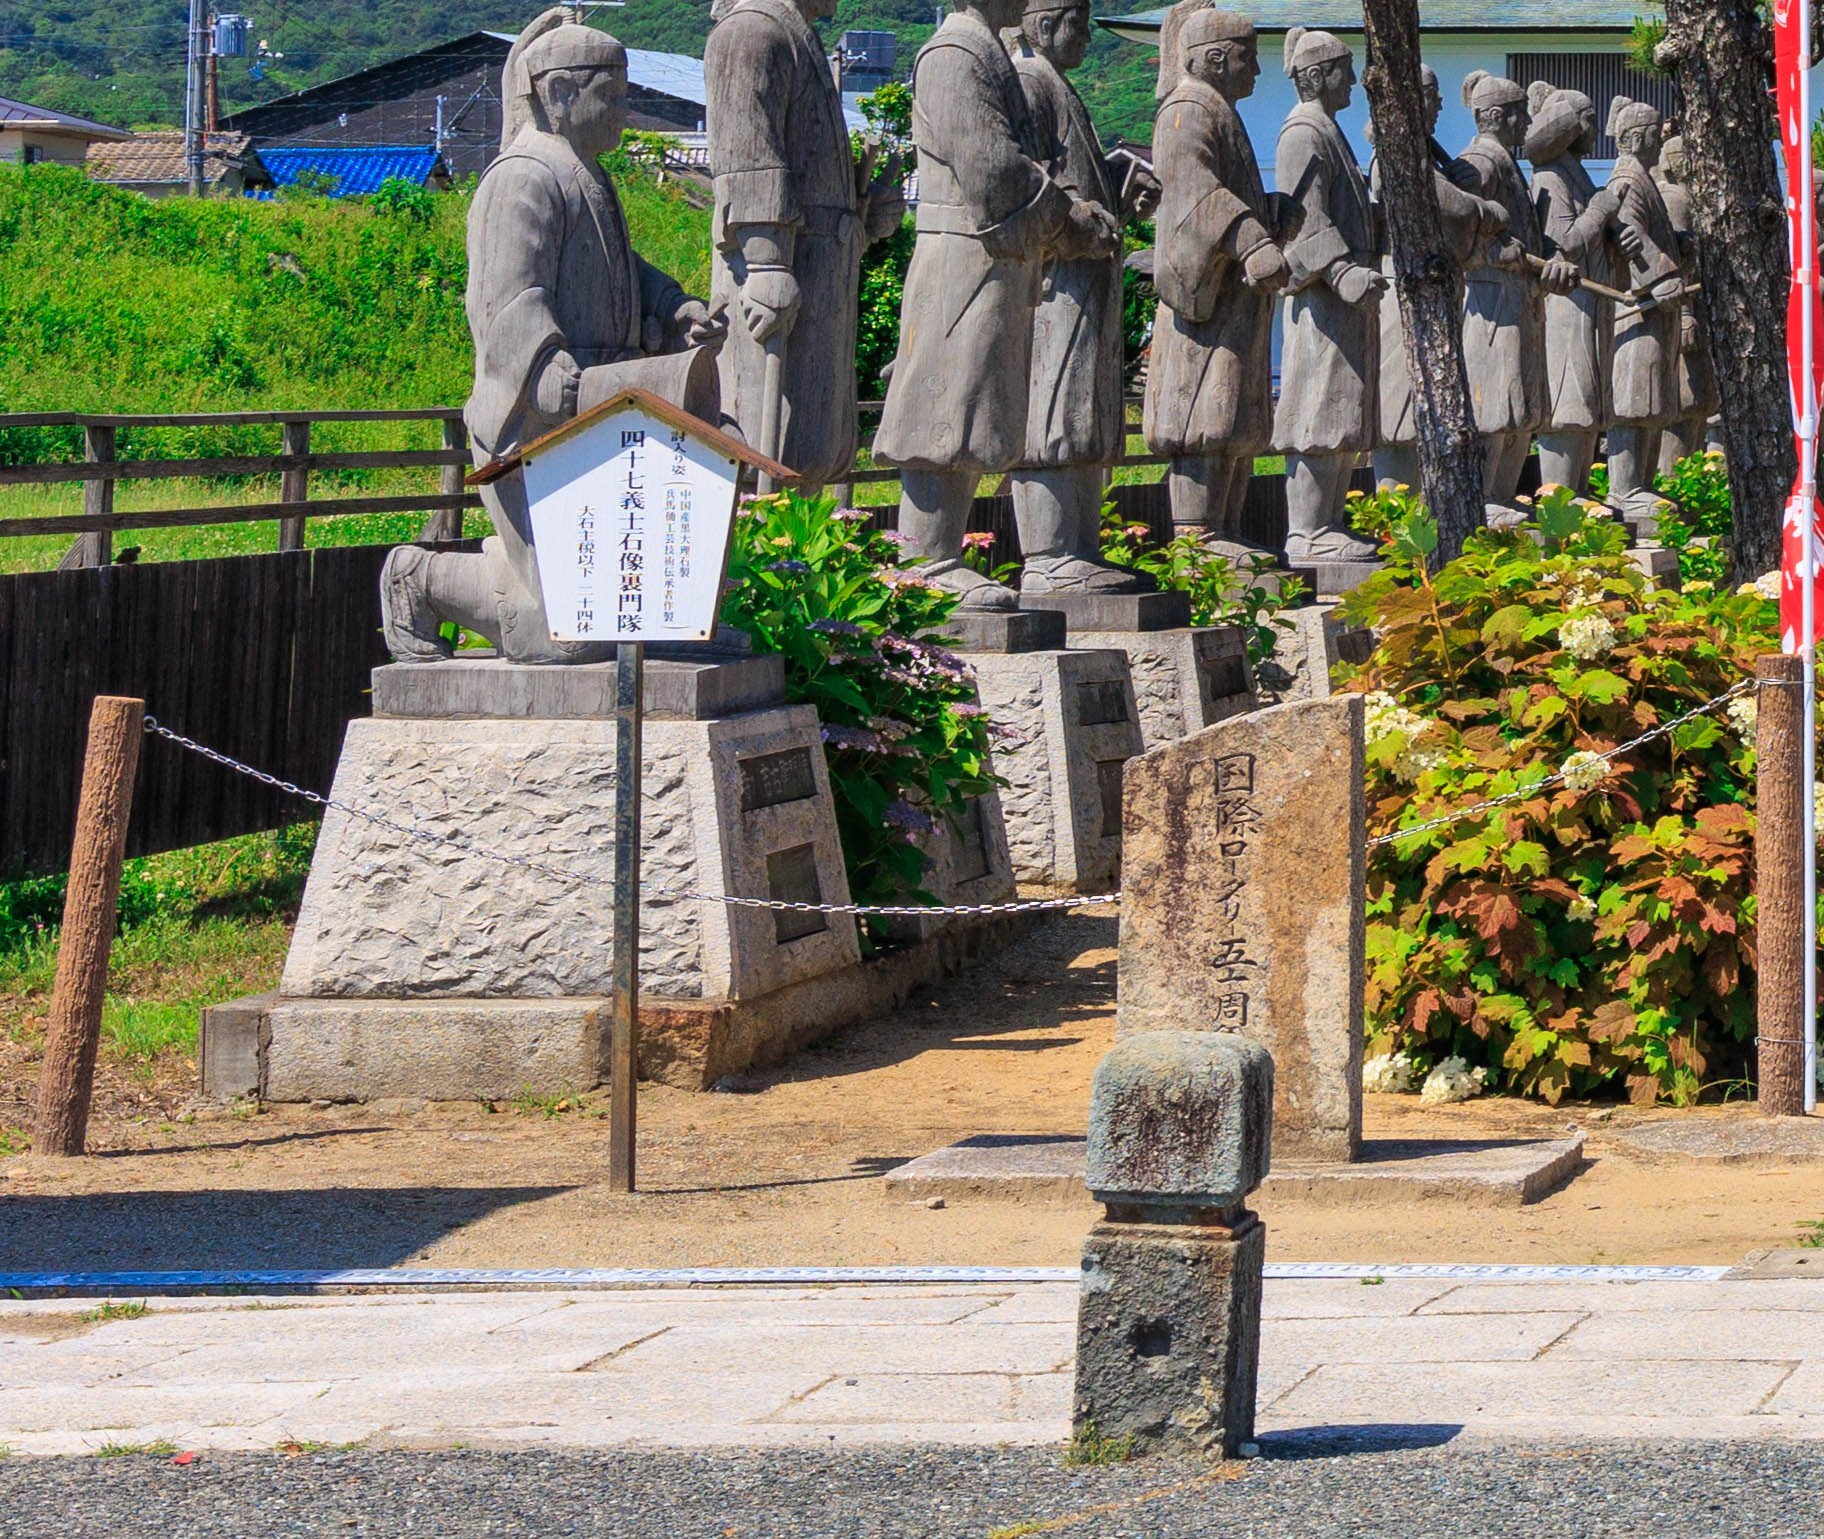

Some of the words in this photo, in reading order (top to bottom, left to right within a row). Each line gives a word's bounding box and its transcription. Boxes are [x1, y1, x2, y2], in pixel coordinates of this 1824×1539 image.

[671, 430, 687, 475] 討入り姿
[617, 430, 646, 633] 四十七義士石像裏門隊
